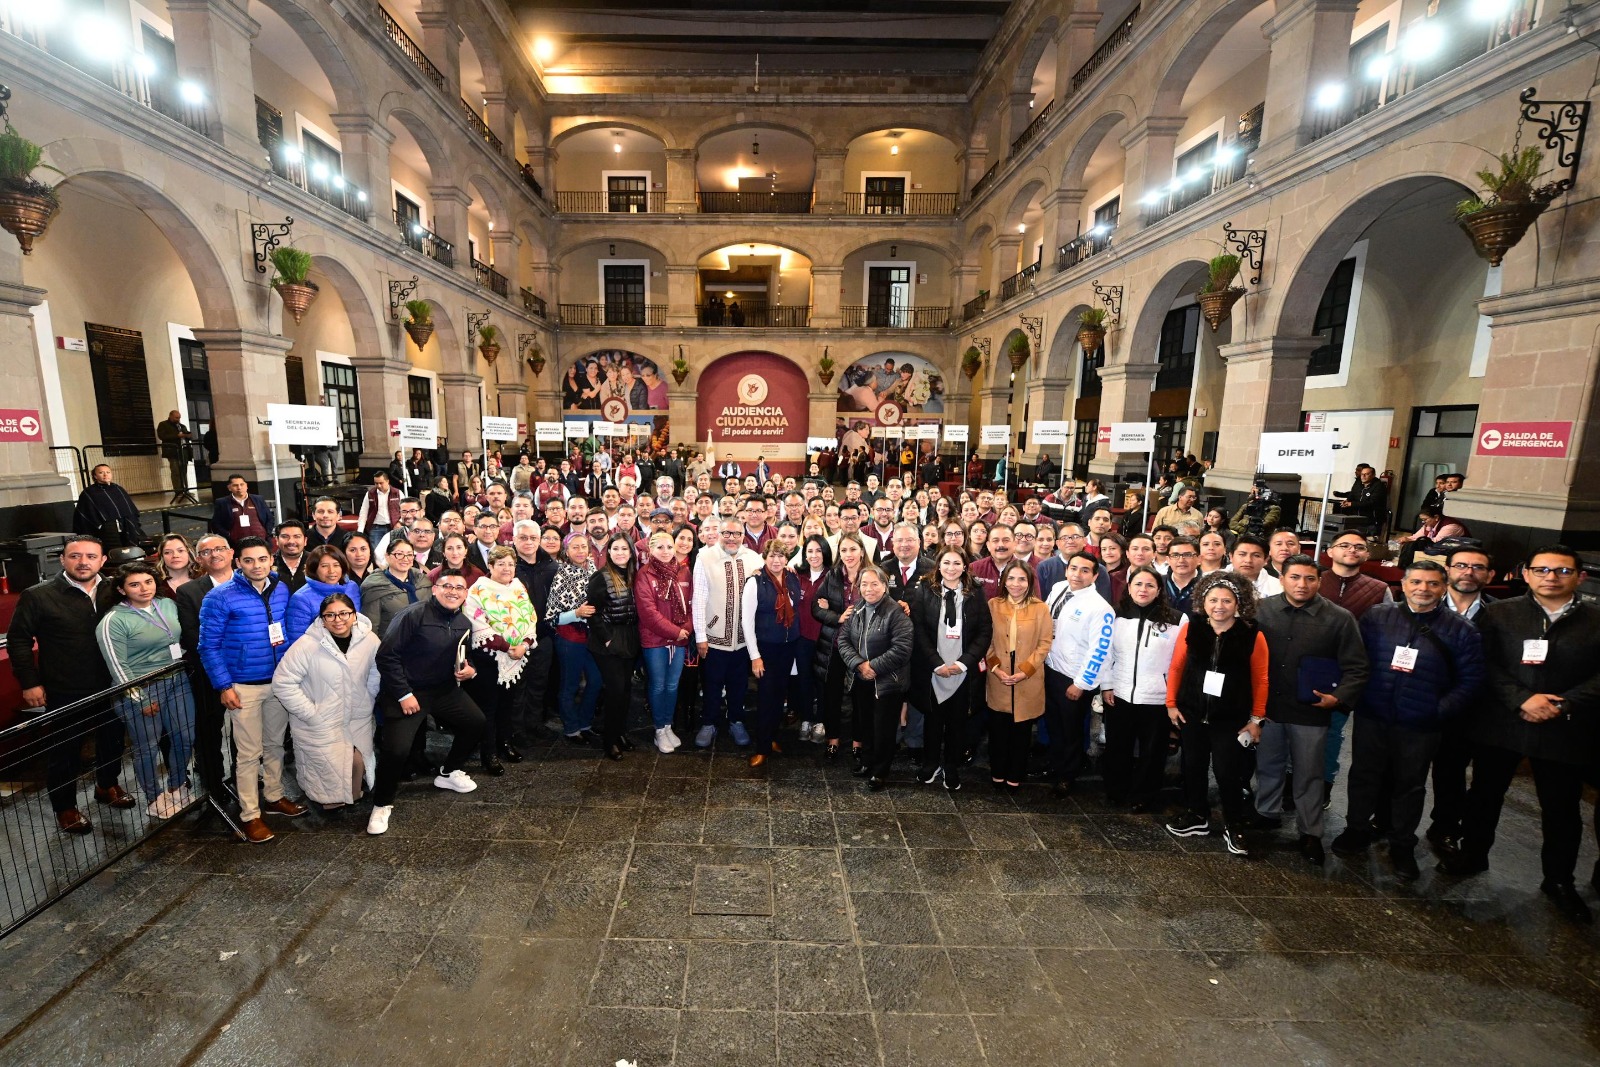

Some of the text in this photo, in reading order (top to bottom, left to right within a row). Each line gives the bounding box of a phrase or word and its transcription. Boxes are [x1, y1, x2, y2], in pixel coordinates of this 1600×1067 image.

[721, 406, 784, 416] AUDIENCIA
[5, 418, 18, 426] DE
[715, 416, 790, 427] CIUDADANA
[721, 427, 784, 437] ¡El poder de servir!
[1503, 432, 1554, 440] SALIDA DE
[1502, 440, 1564, 448] EMERGENCIA
[1277, 449, 1315, 457] DIFEM
[1082, 612, 1114, 686] CODHEM
